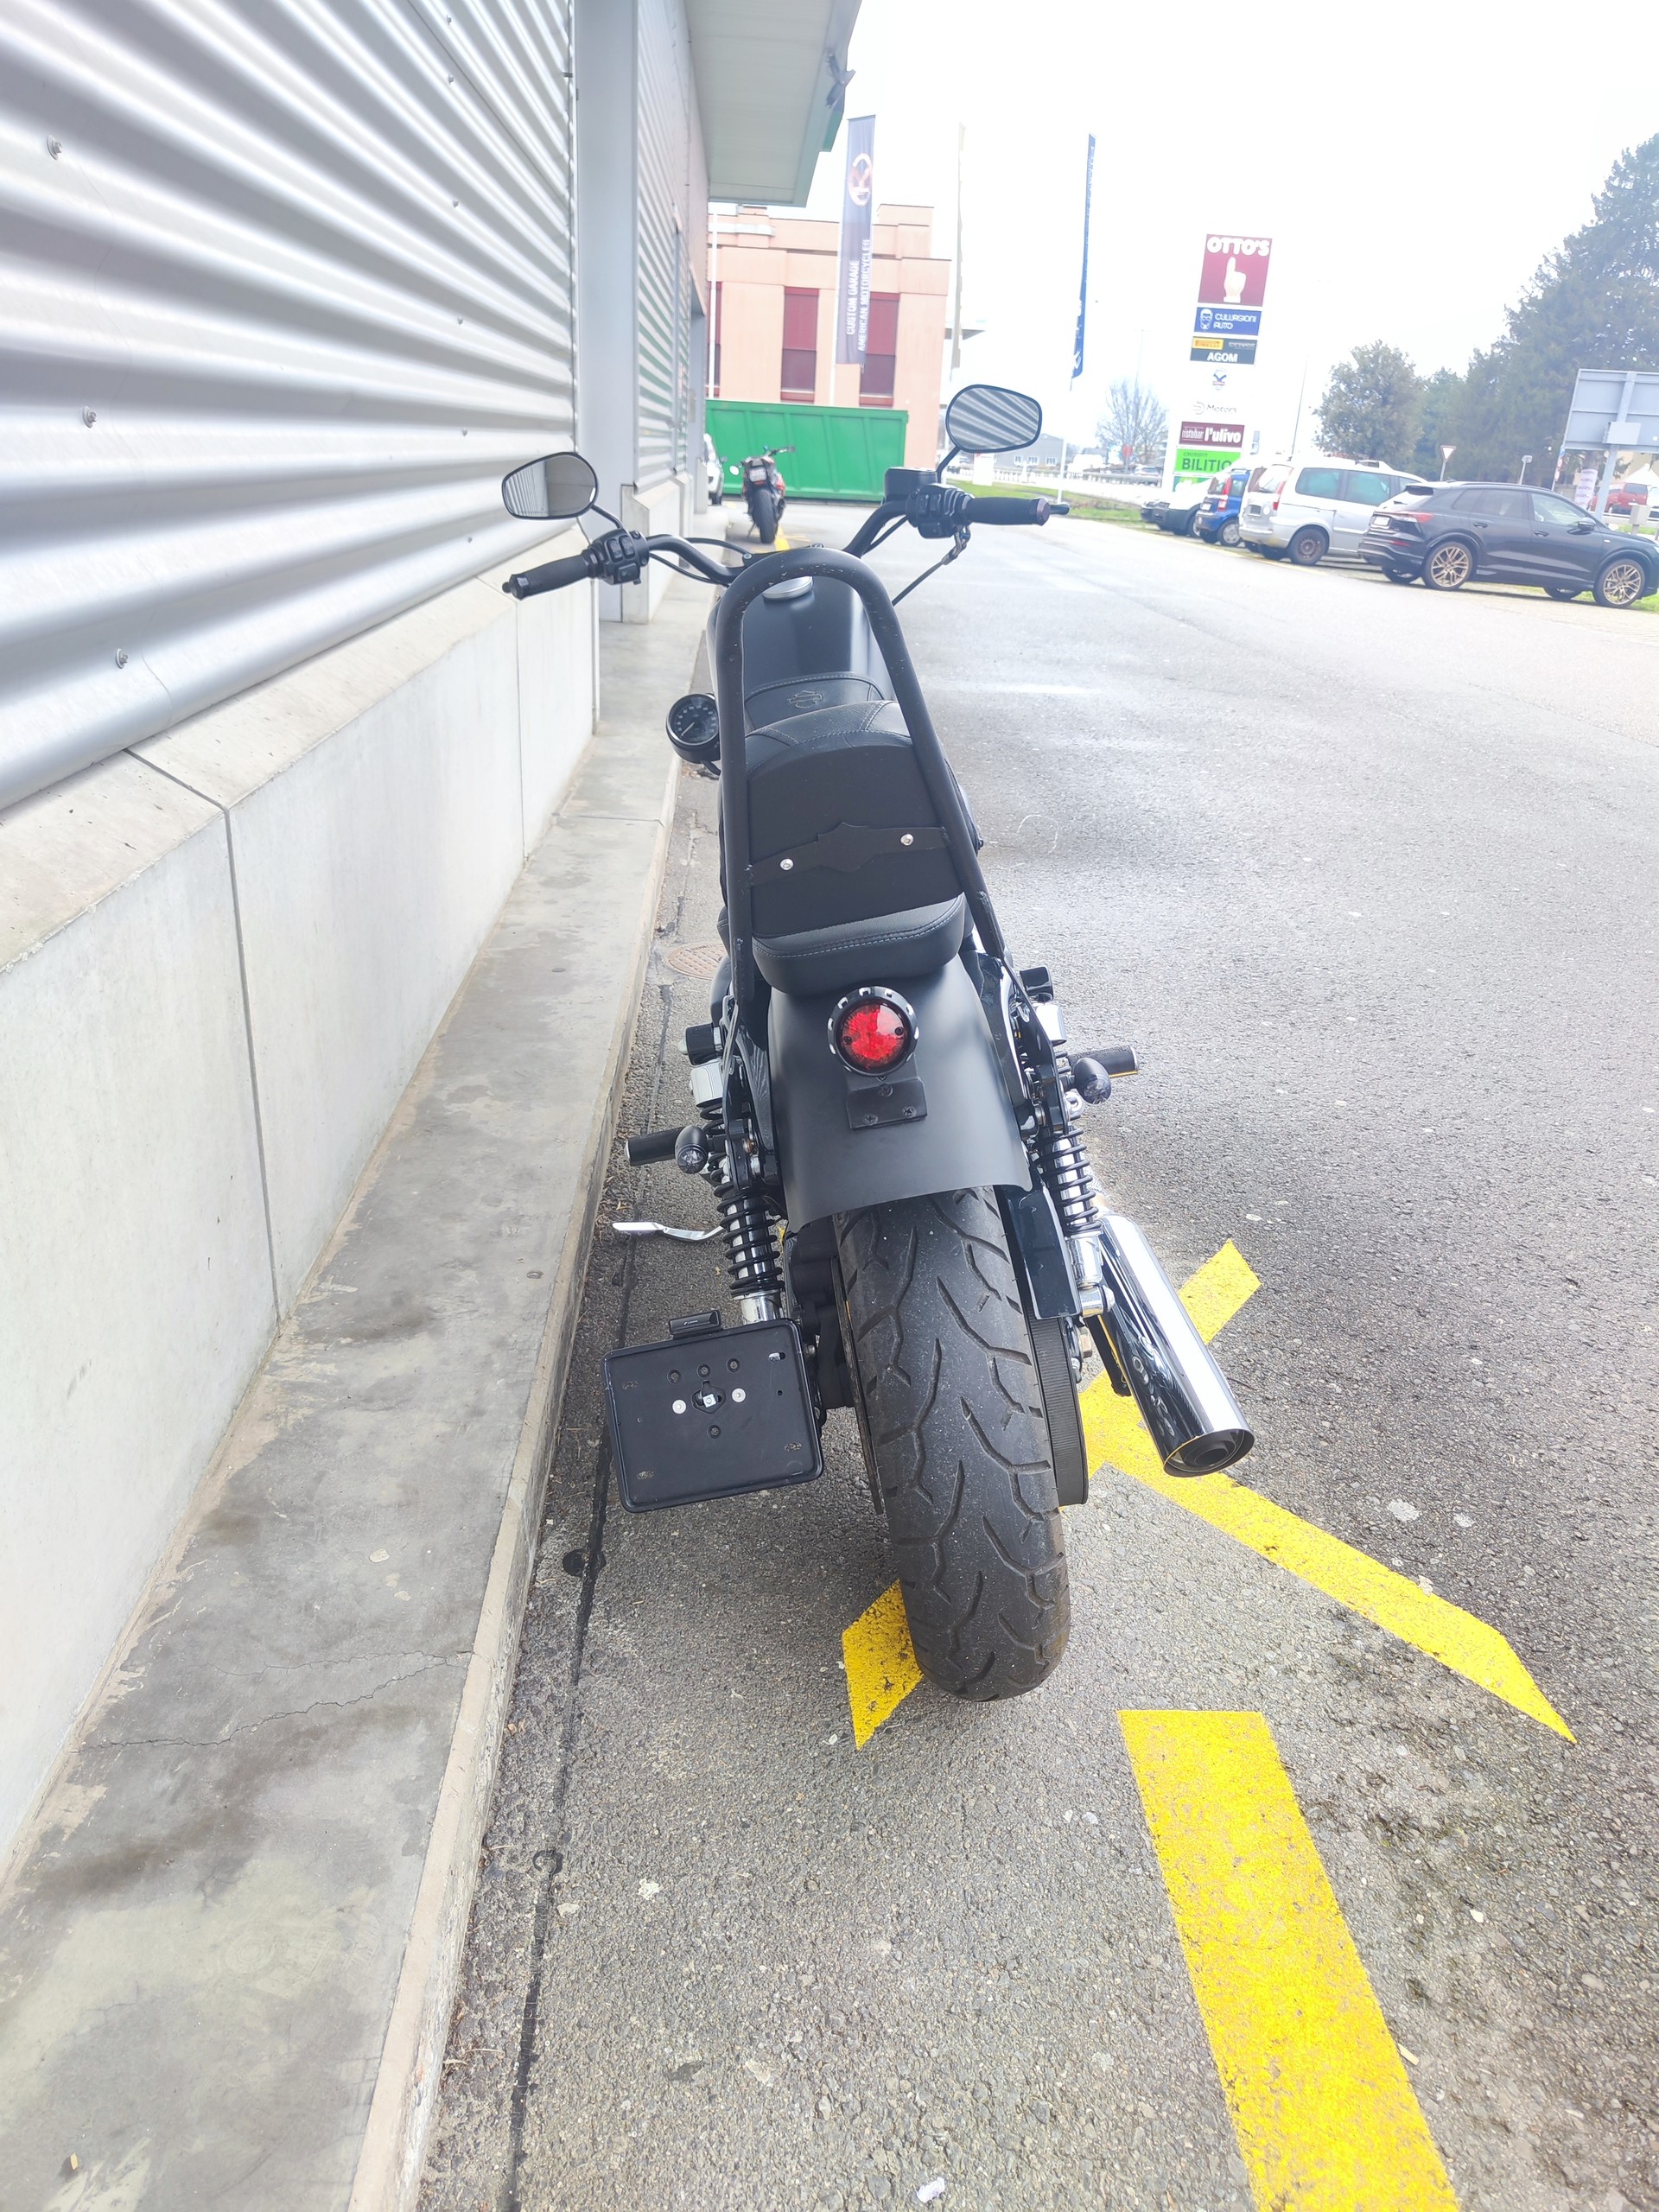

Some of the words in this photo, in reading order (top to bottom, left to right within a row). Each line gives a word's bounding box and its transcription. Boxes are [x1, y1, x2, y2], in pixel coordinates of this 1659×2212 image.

[1207, 236, 1270, 257] OTTO'S
[849, 261, 860, 296] GARAGE
[861, 239, 871, 305] MOTORCYCLES
[847, 297, 858, 334] CUSTOM
[858, 308, 868, 351] AMERICAN
[1207, 352, 1238, 362] AGOM
